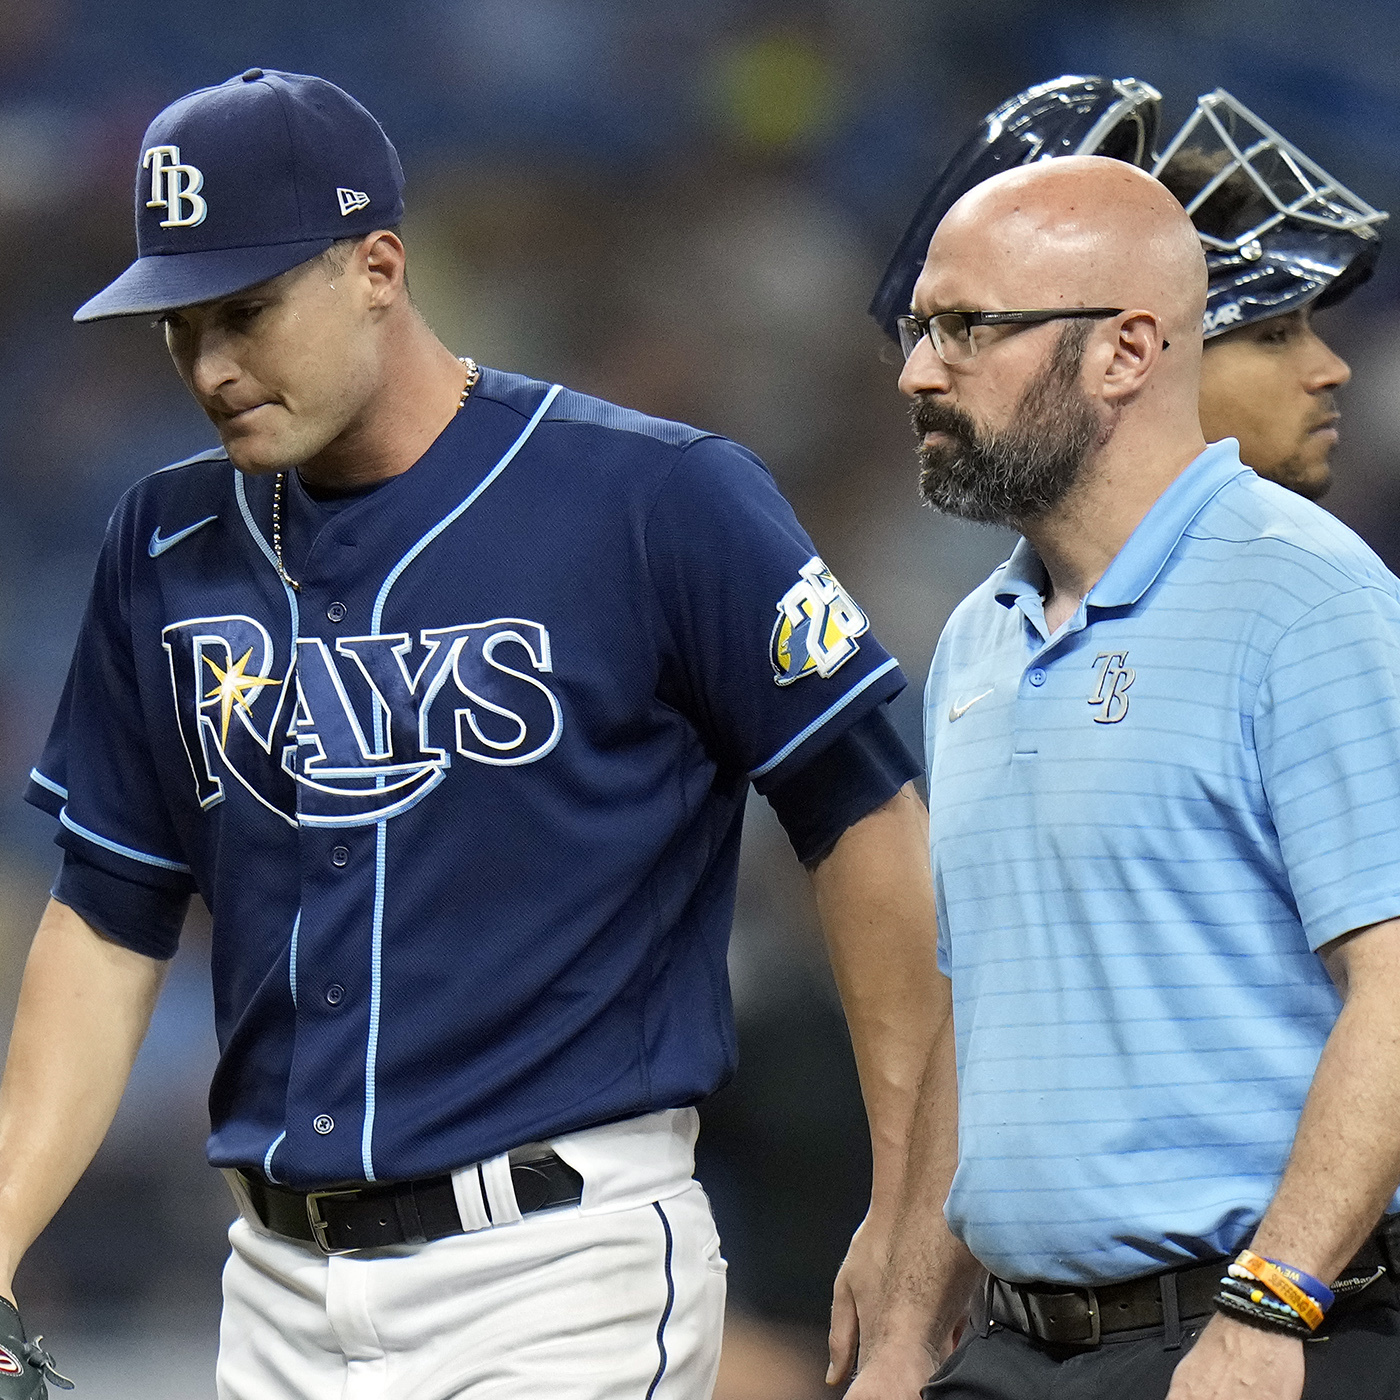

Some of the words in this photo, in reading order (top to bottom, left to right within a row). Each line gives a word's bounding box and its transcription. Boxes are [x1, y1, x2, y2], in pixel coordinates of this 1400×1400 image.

[142, 145, 208, 228] TB
[782, 555, 870, 679] 25
[161, 614, 565, 829] RAYS
[1087, 650, 1137, 725] TB
